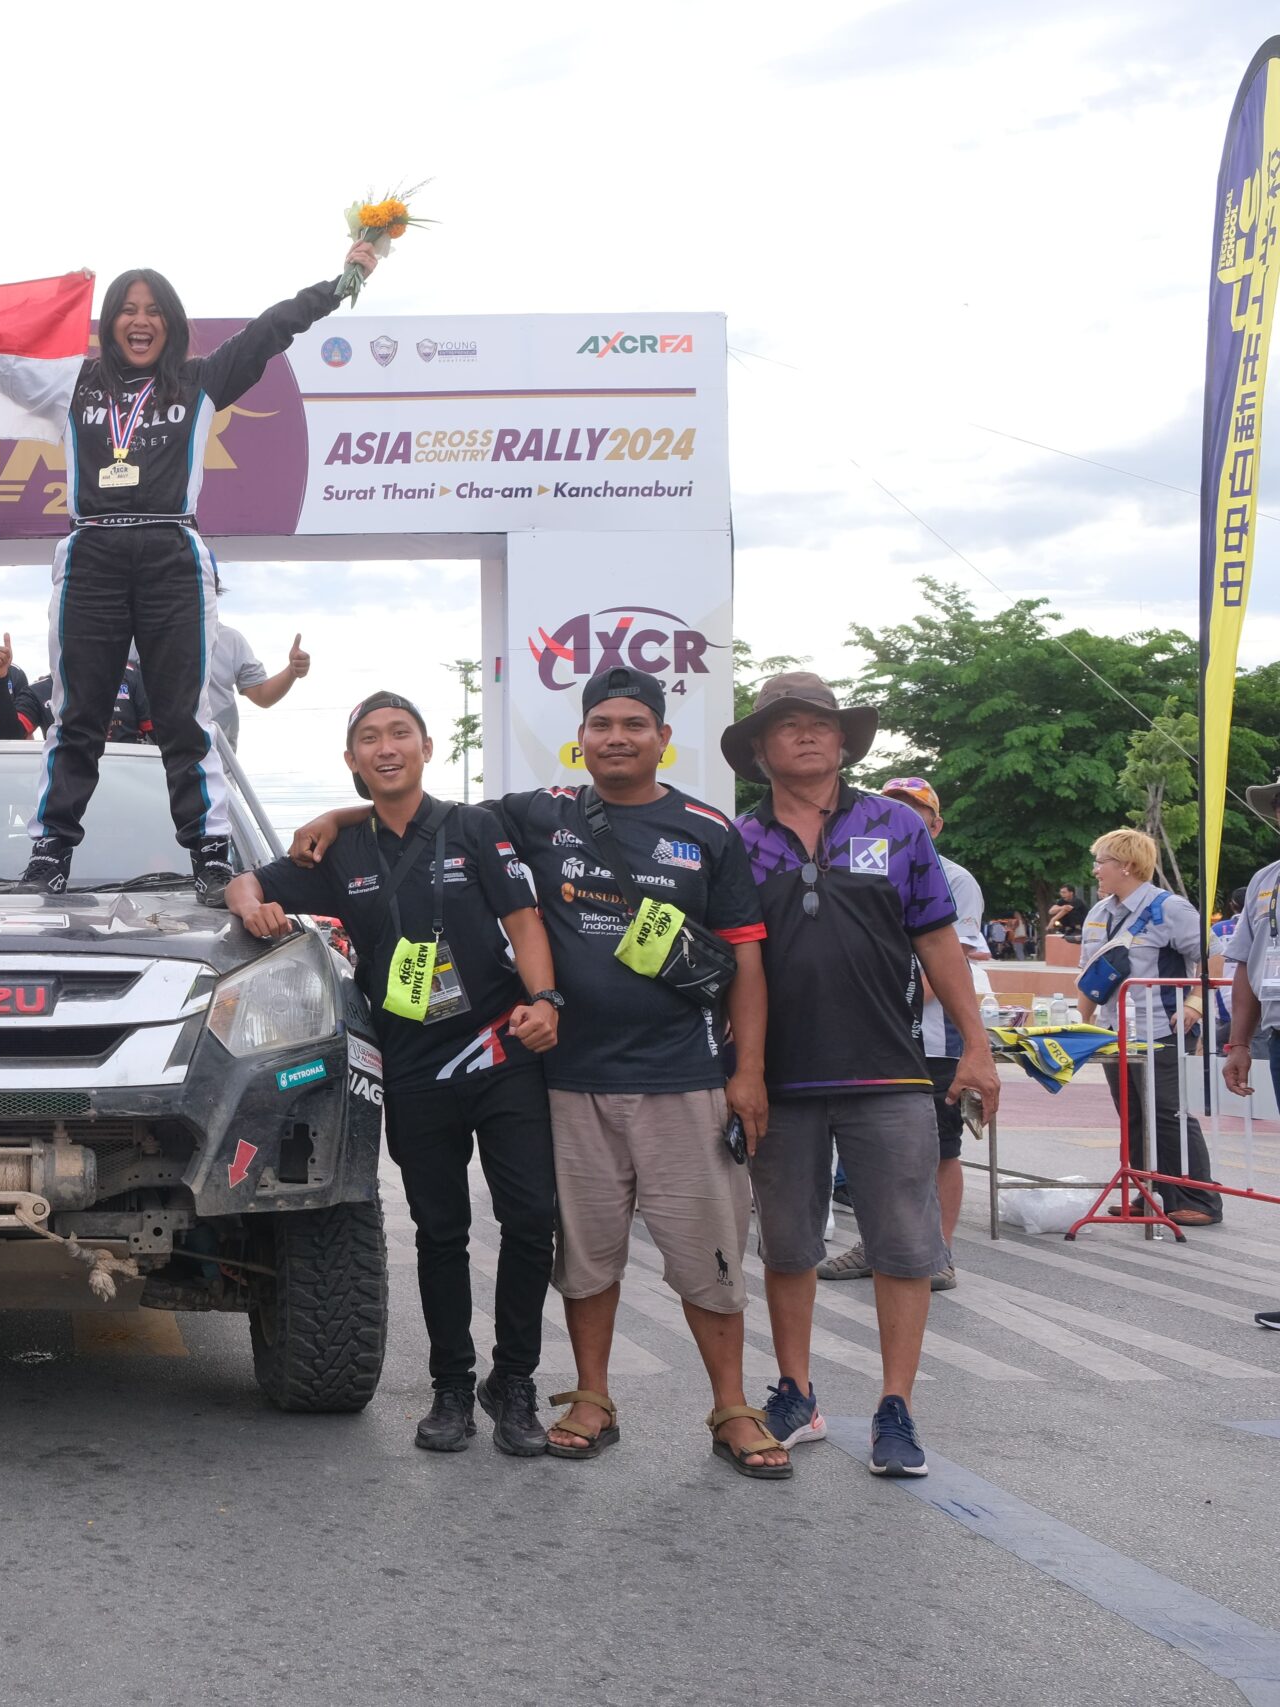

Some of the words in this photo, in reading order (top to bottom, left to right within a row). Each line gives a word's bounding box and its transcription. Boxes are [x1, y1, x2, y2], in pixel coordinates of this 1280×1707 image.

[438, 341, 477, 350] YOUNG
[576, 331, 694, 359] AXCRFA
[324, 431, 412, 465] ASIA
[415, 430, 494, 448] CROSS
[414, 449, 490, 463] COUNTRY
[323, 484, 376, 501] Surat
[382, 482, 436, 500] Thani
[456, 481, 533, 500] Cha-am
[553, 480, 693, 499] Kanchanaburi
[528, 613, 711, 691] AXCR
[671, 841, 700, 862] 116
[579, 912, 620, 923] Telkom
[636, 922, 652, 946] CREW
[416, 944, 428, 968] CREW
[411, 970, 425, 1005] SERVICE
[288, 1064, 324, 1082] PETRONAS
